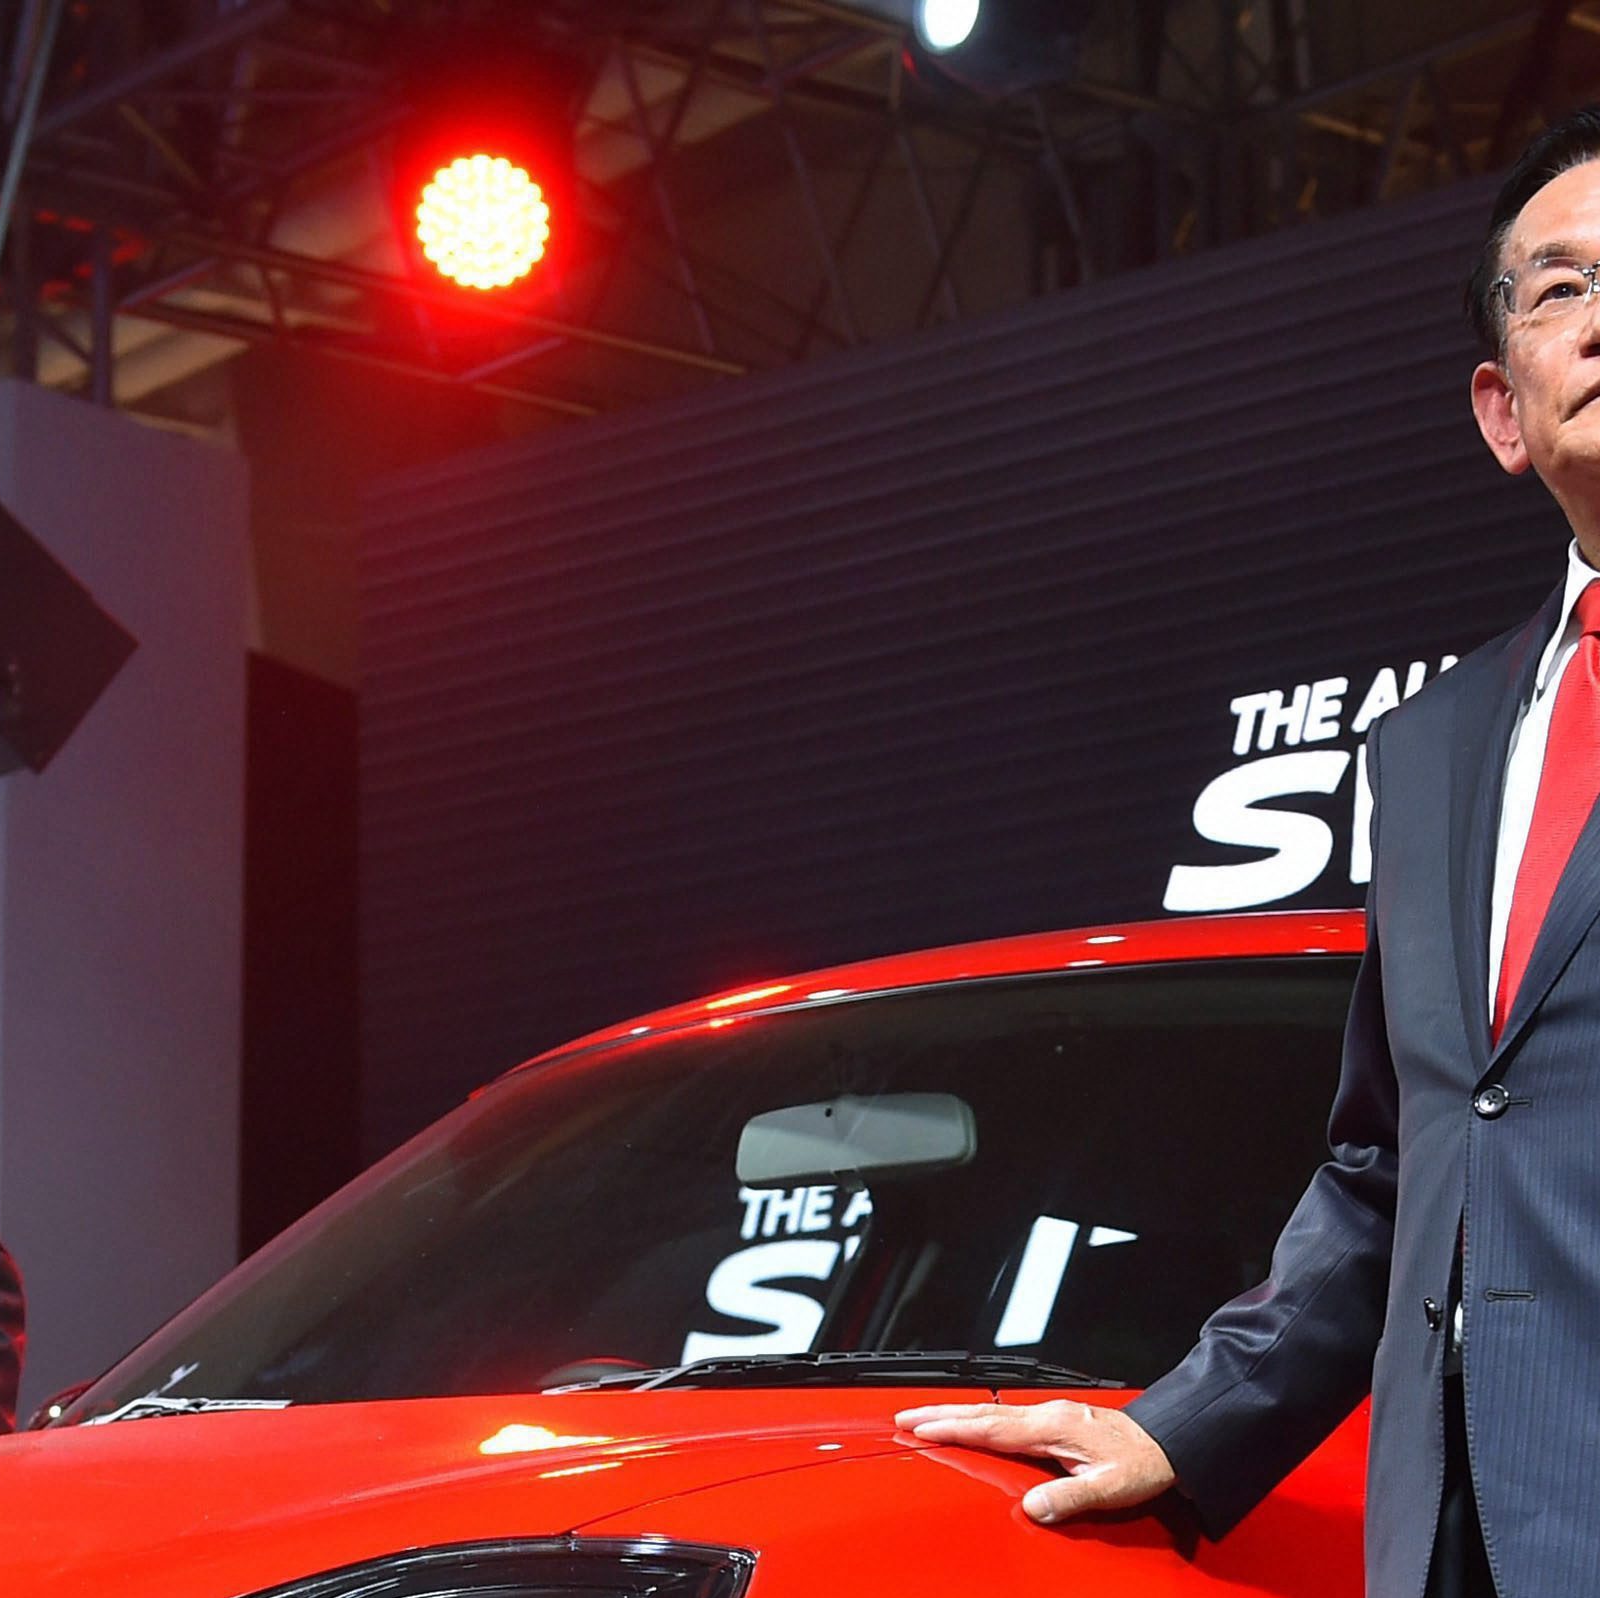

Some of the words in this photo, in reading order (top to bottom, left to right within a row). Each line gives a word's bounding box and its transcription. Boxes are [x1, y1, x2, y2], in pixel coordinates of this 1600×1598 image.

[1230, 676, 1349, 755] THE
[1162, 743, 1375, 912] S
[738, 1185, 838, 1240] THE
